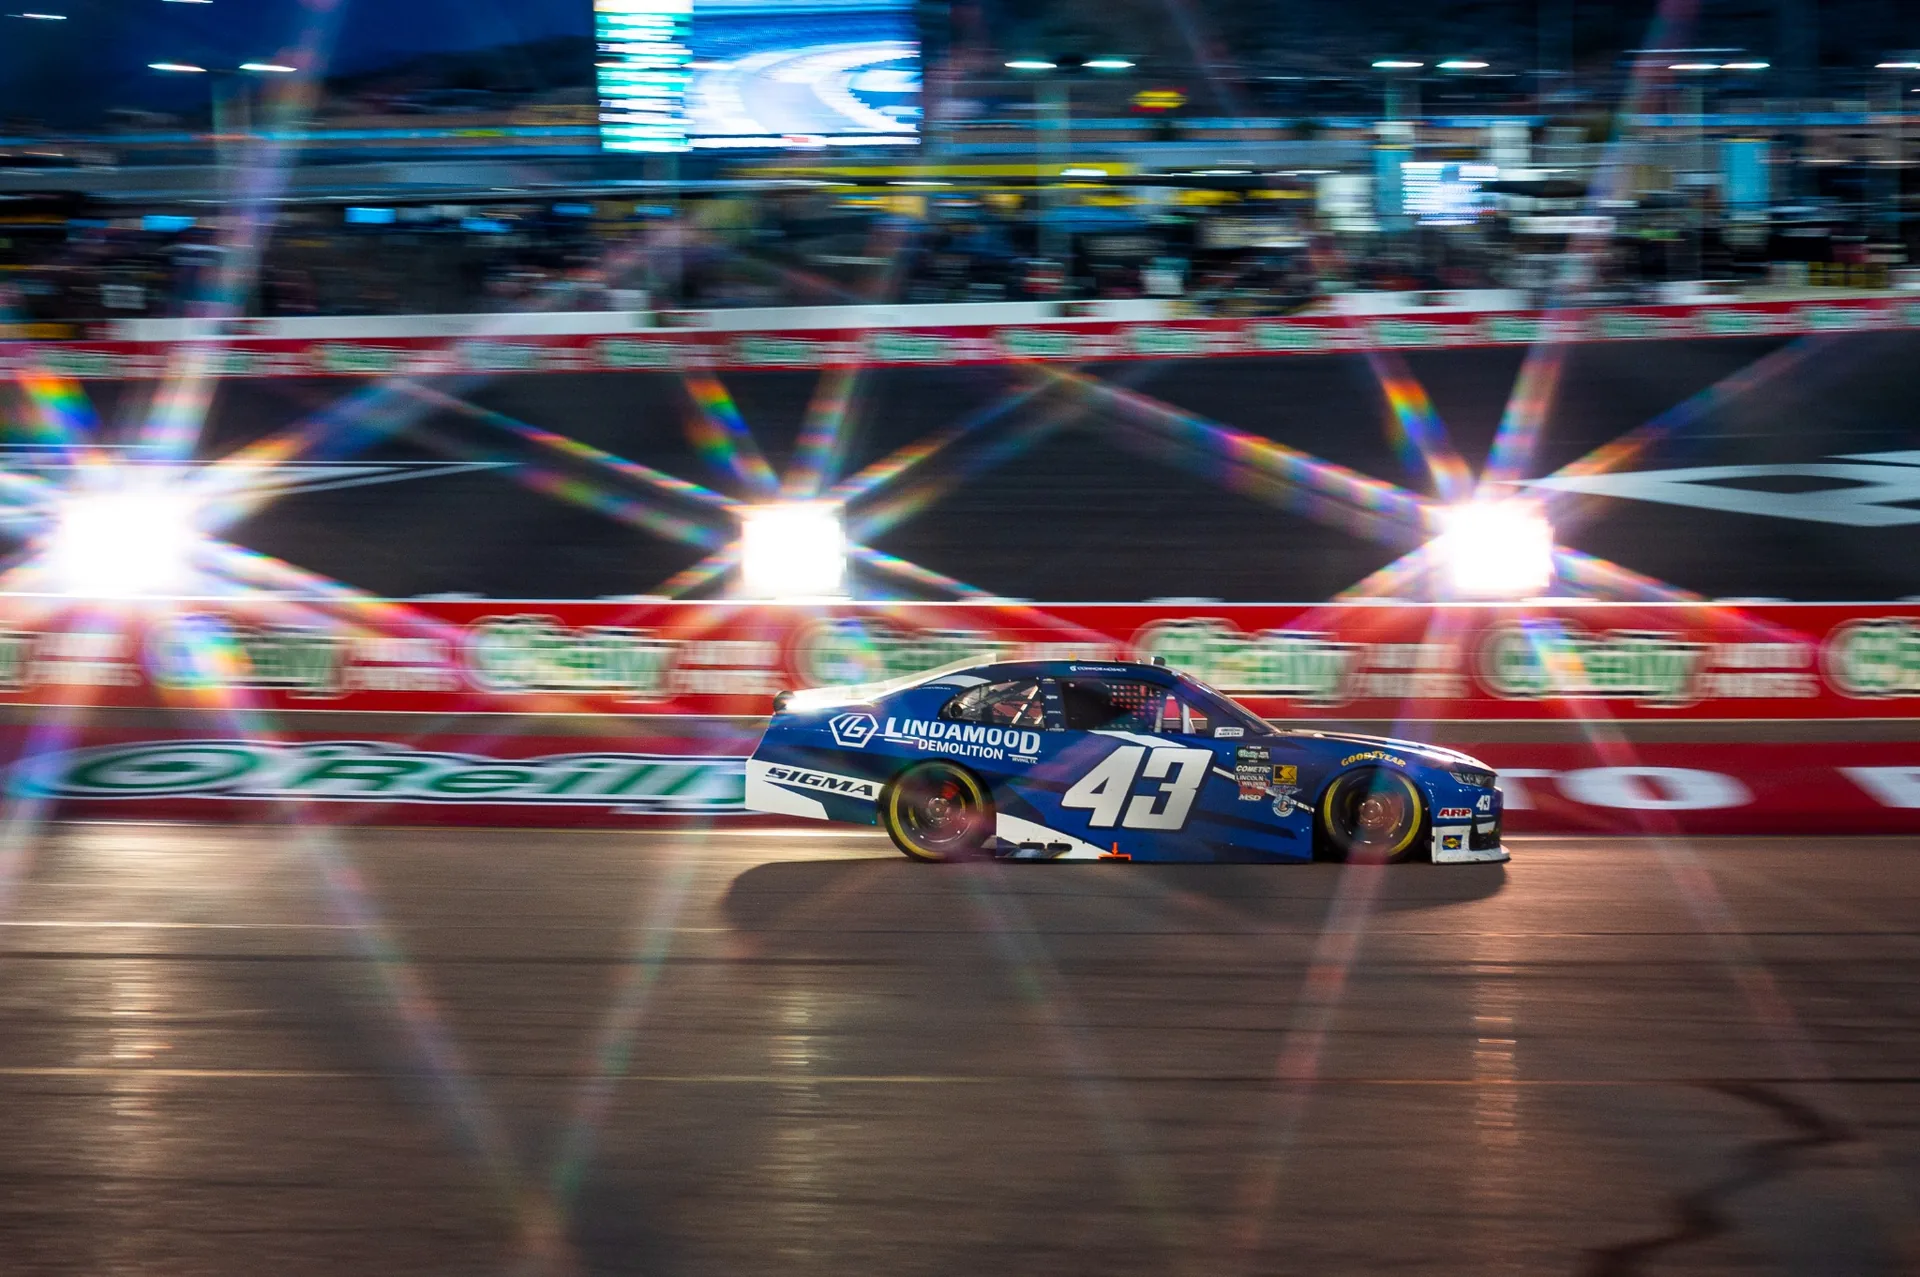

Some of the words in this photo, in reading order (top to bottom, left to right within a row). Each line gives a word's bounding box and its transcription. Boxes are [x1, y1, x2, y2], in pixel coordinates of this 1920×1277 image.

[885, 717, 1041, 755] LINDAMOOD
[918, 739, 1004, 760] DEMOLITION
[1341, 750, 1406, 767] GOODYEAR
[1236, 765, 1271, 774] COMETIC
[765, 767, 873, 796] SIGMA
[1061, 746, 1213, 830] 43
[1476, 795, 1491, 811] 43
[1437, 807, 1472, 819] ARP
